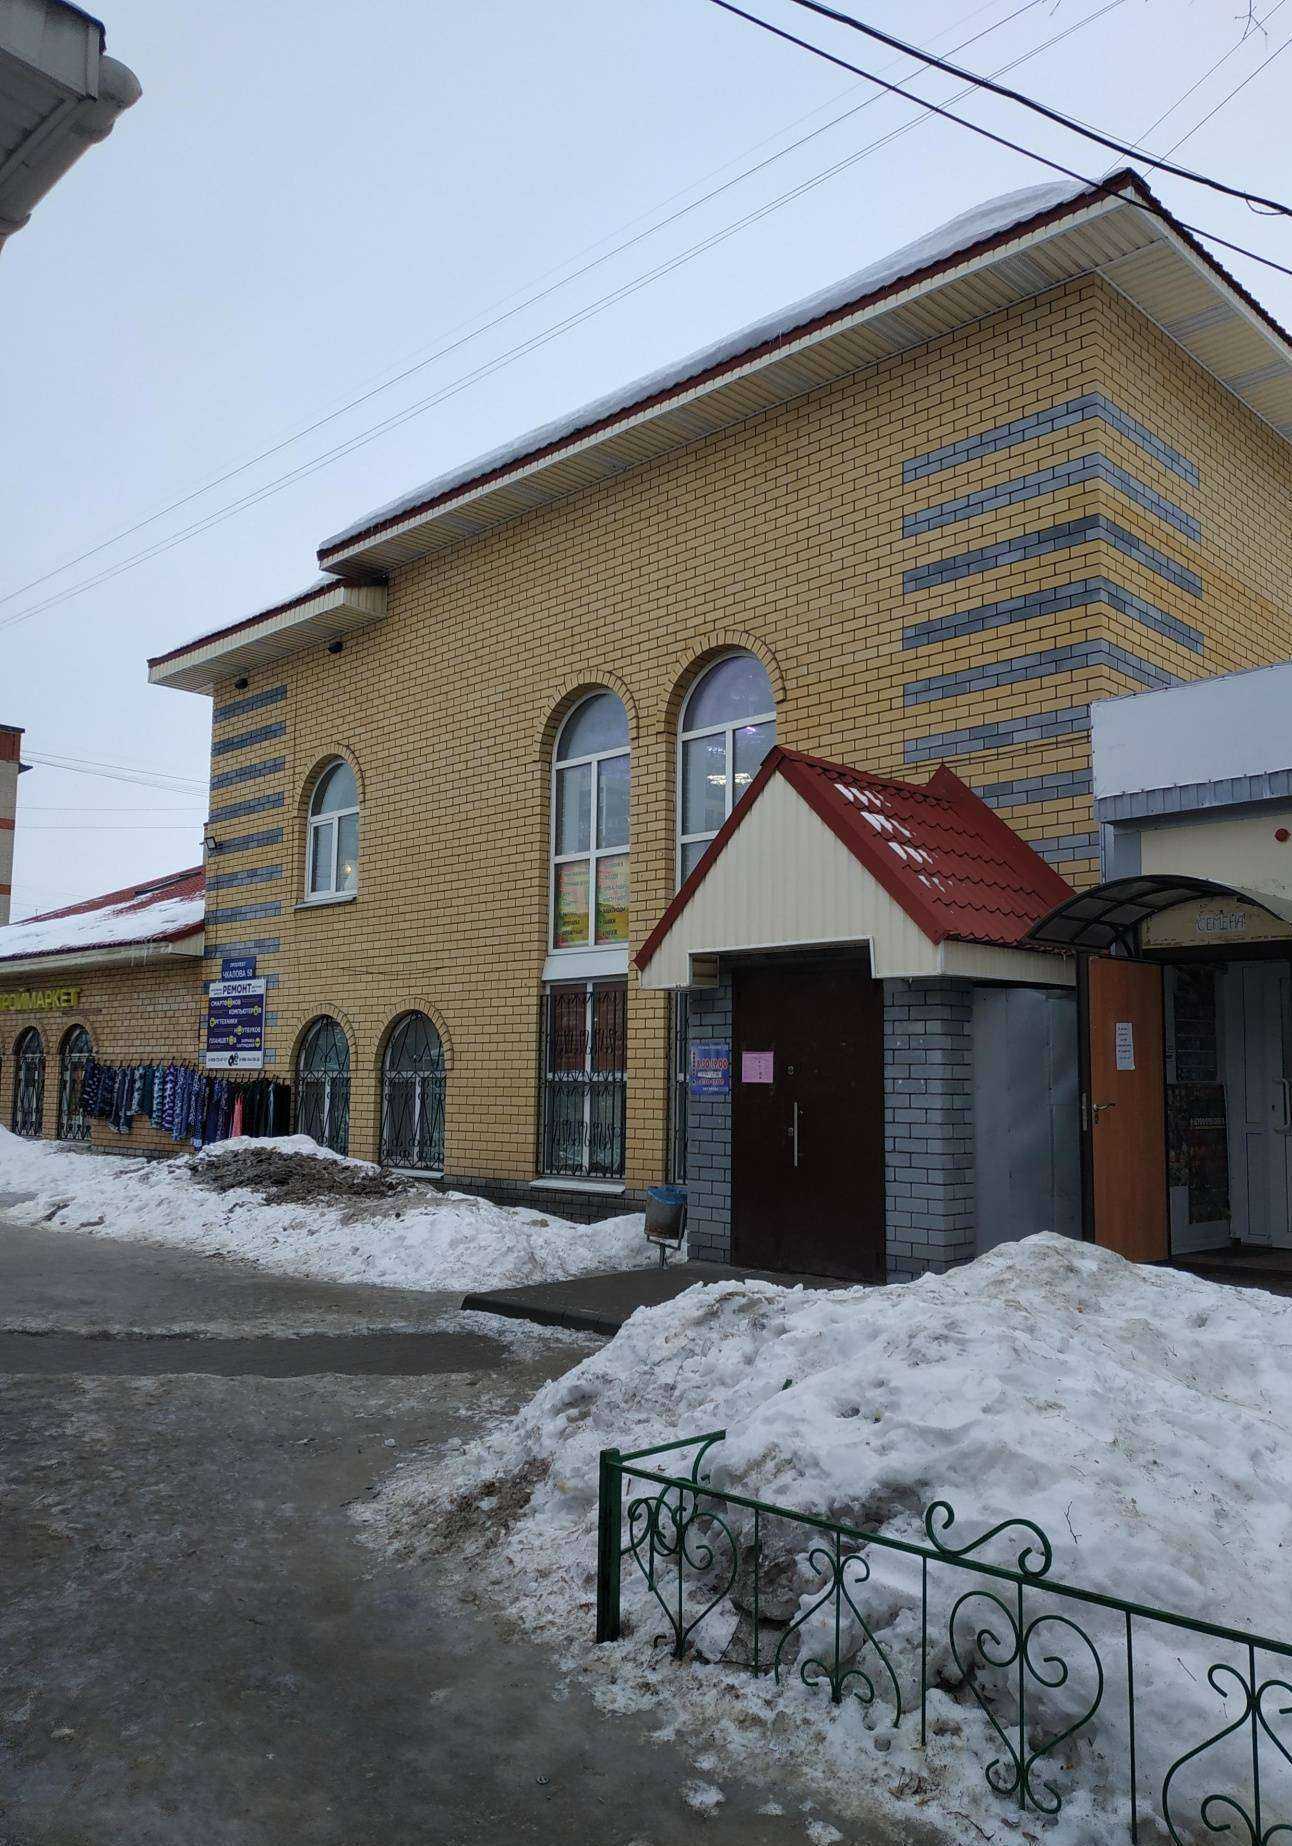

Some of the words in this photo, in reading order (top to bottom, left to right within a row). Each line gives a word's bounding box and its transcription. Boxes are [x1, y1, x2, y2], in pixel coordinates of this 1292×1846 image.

[1197, 911, 1246, 931] СЕМЕНА
[222, 970, 246, 979] ЧКАЛОВА
[222, 983, 253, 995] РЕМОНТ
